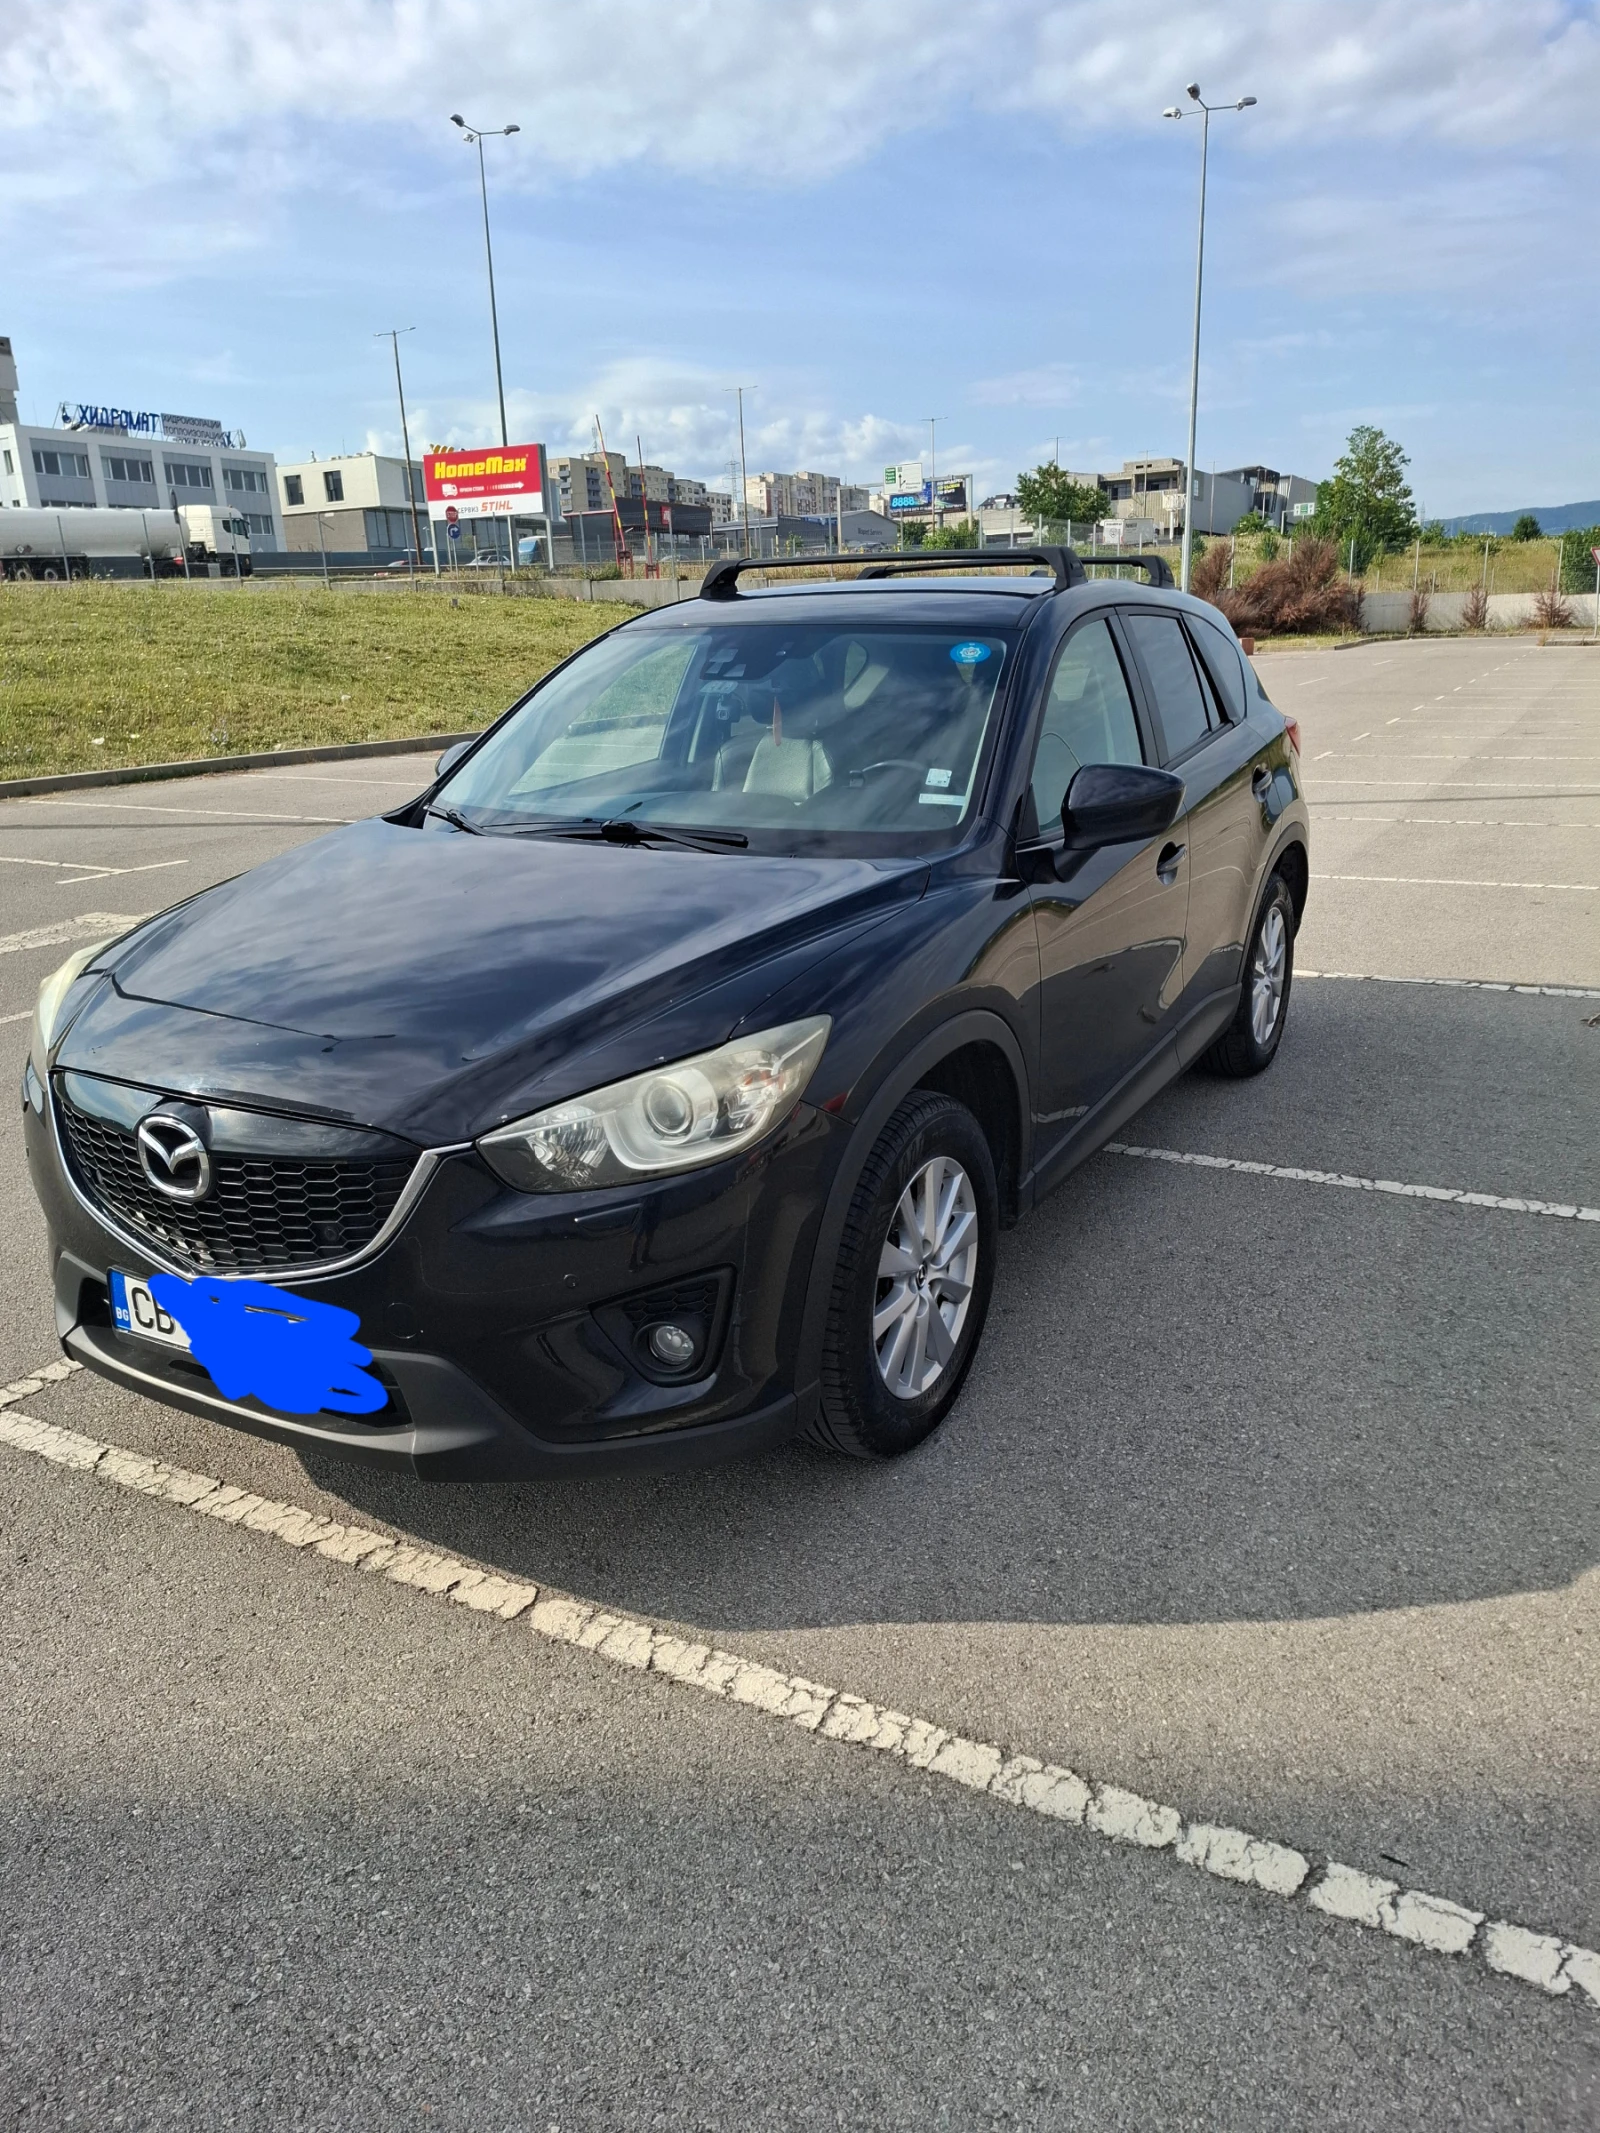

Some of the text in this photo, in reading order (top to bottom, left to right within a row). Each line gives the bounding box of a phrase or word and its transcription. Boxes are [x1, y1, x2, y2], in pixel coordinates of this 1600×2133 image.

[79, 404, 160, 432] ХИДРОМАТ
[434, 456, 526, 479] HomeMax
[481, 500, 513, 512] STIHL
[115, 1306, 129, 1321] BG
